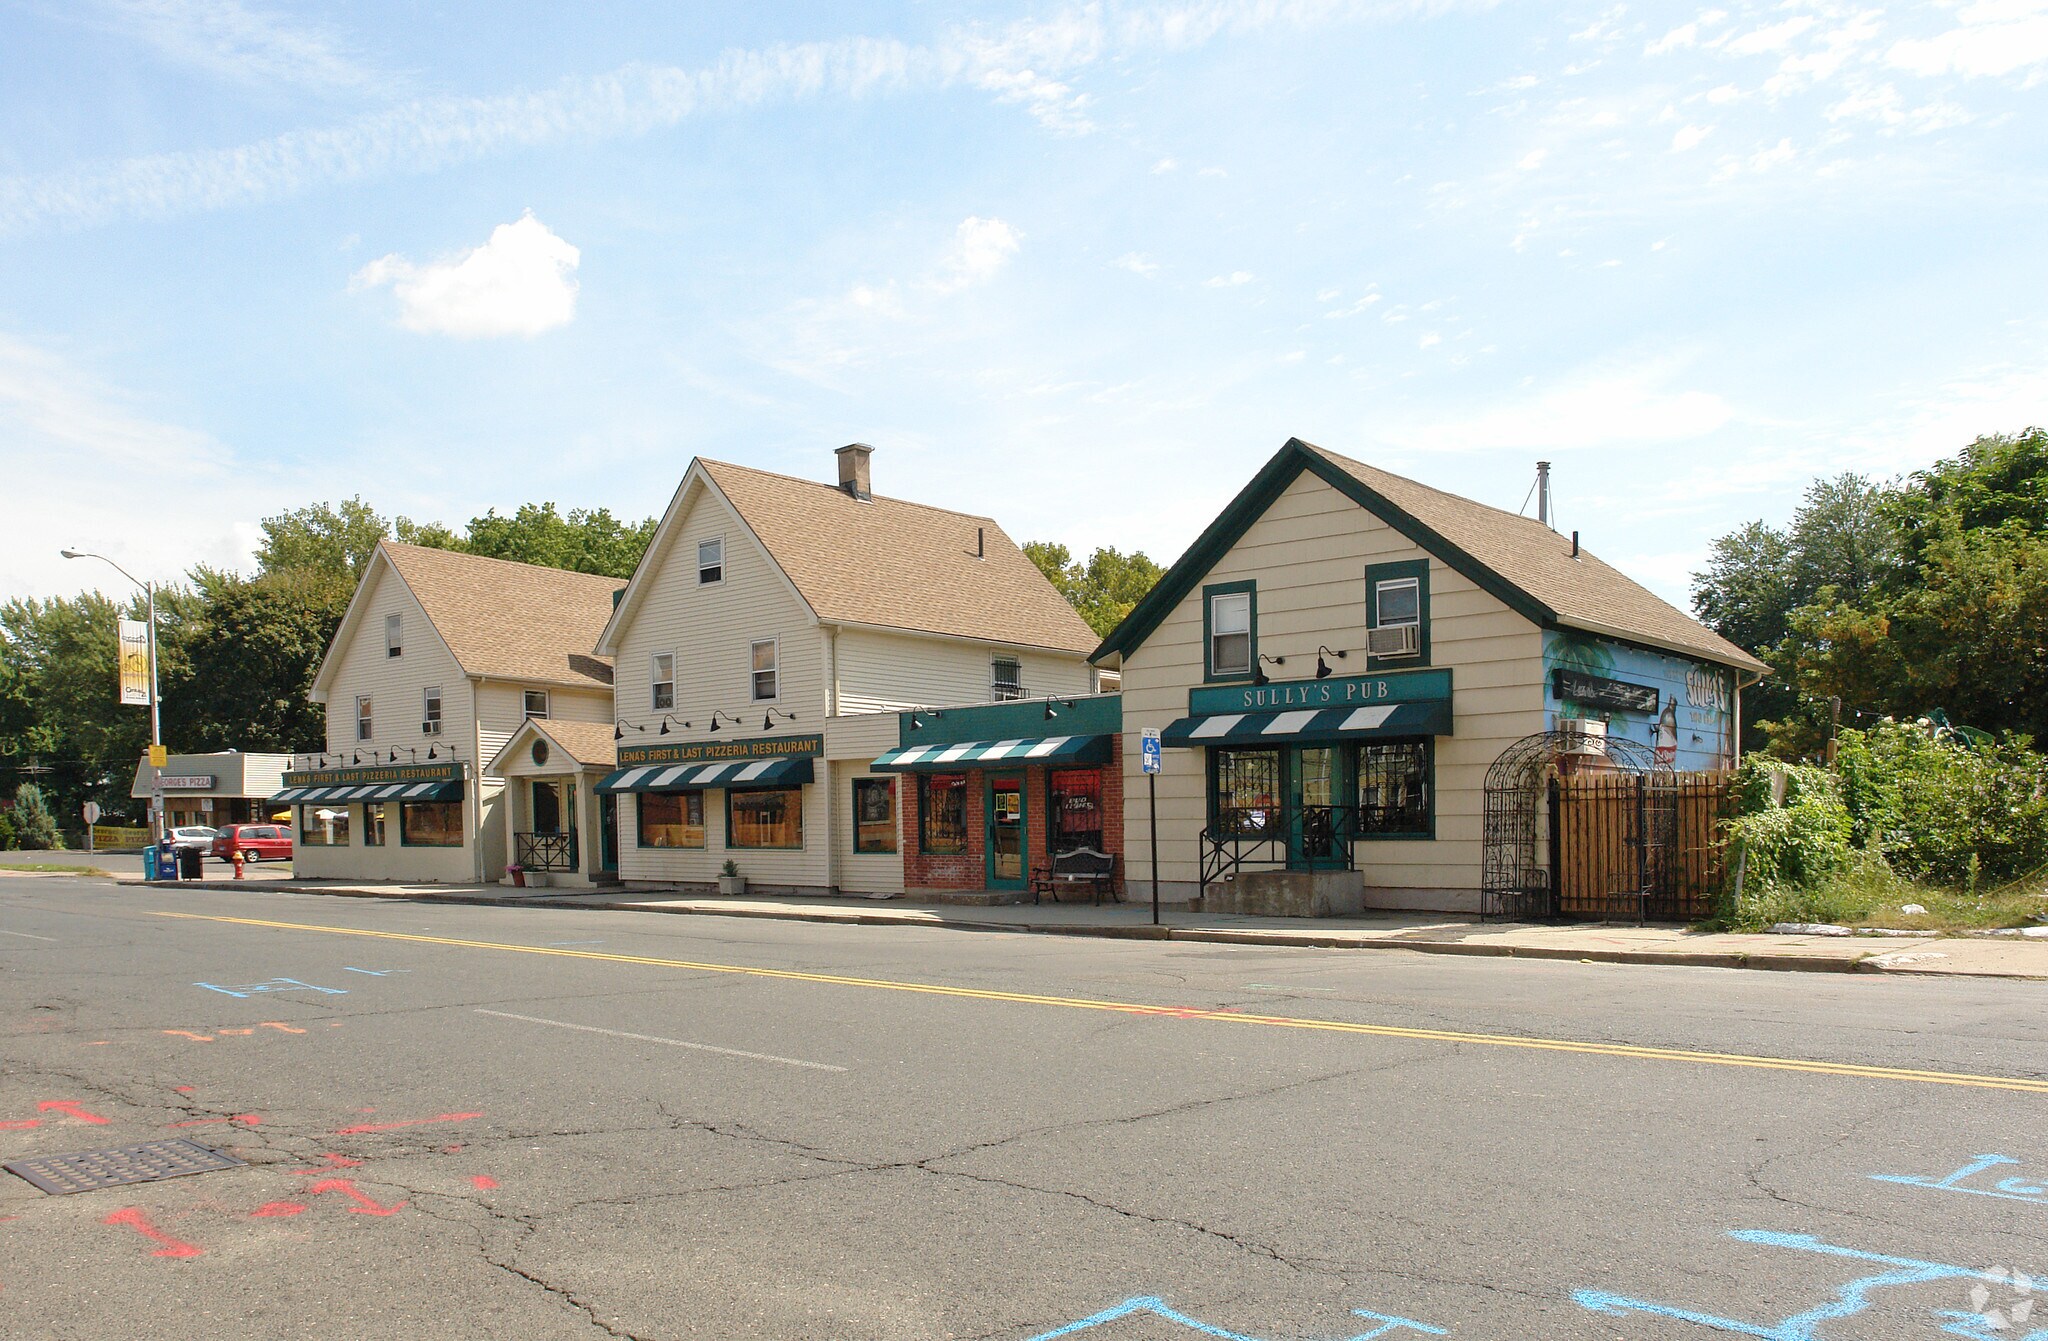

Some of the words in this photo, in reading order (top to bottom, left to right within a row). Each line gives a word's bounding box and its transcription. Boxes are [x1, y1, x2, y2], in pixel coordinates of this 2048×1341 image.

[1243, 684, 1330, 707] SULLY'S
[1346, 681, 1388, 700] PUB
[648, 749, 672, 760] FIRST
[673, 748, 679, 759] &
[682, 747, 702, 758] LAST
[706, 744, 748, 757] PIZZERIA
[752, 740, 818, 755] RESTAURANT
[189, 778, 211, 787] PIZZA
[313, 773, 332, 783] FIRST
[342, 772, 359, 781] LAST
[362, 770, 397, 780] PIZZERIA
[401, 767, 451, 778] RESTAURANT
